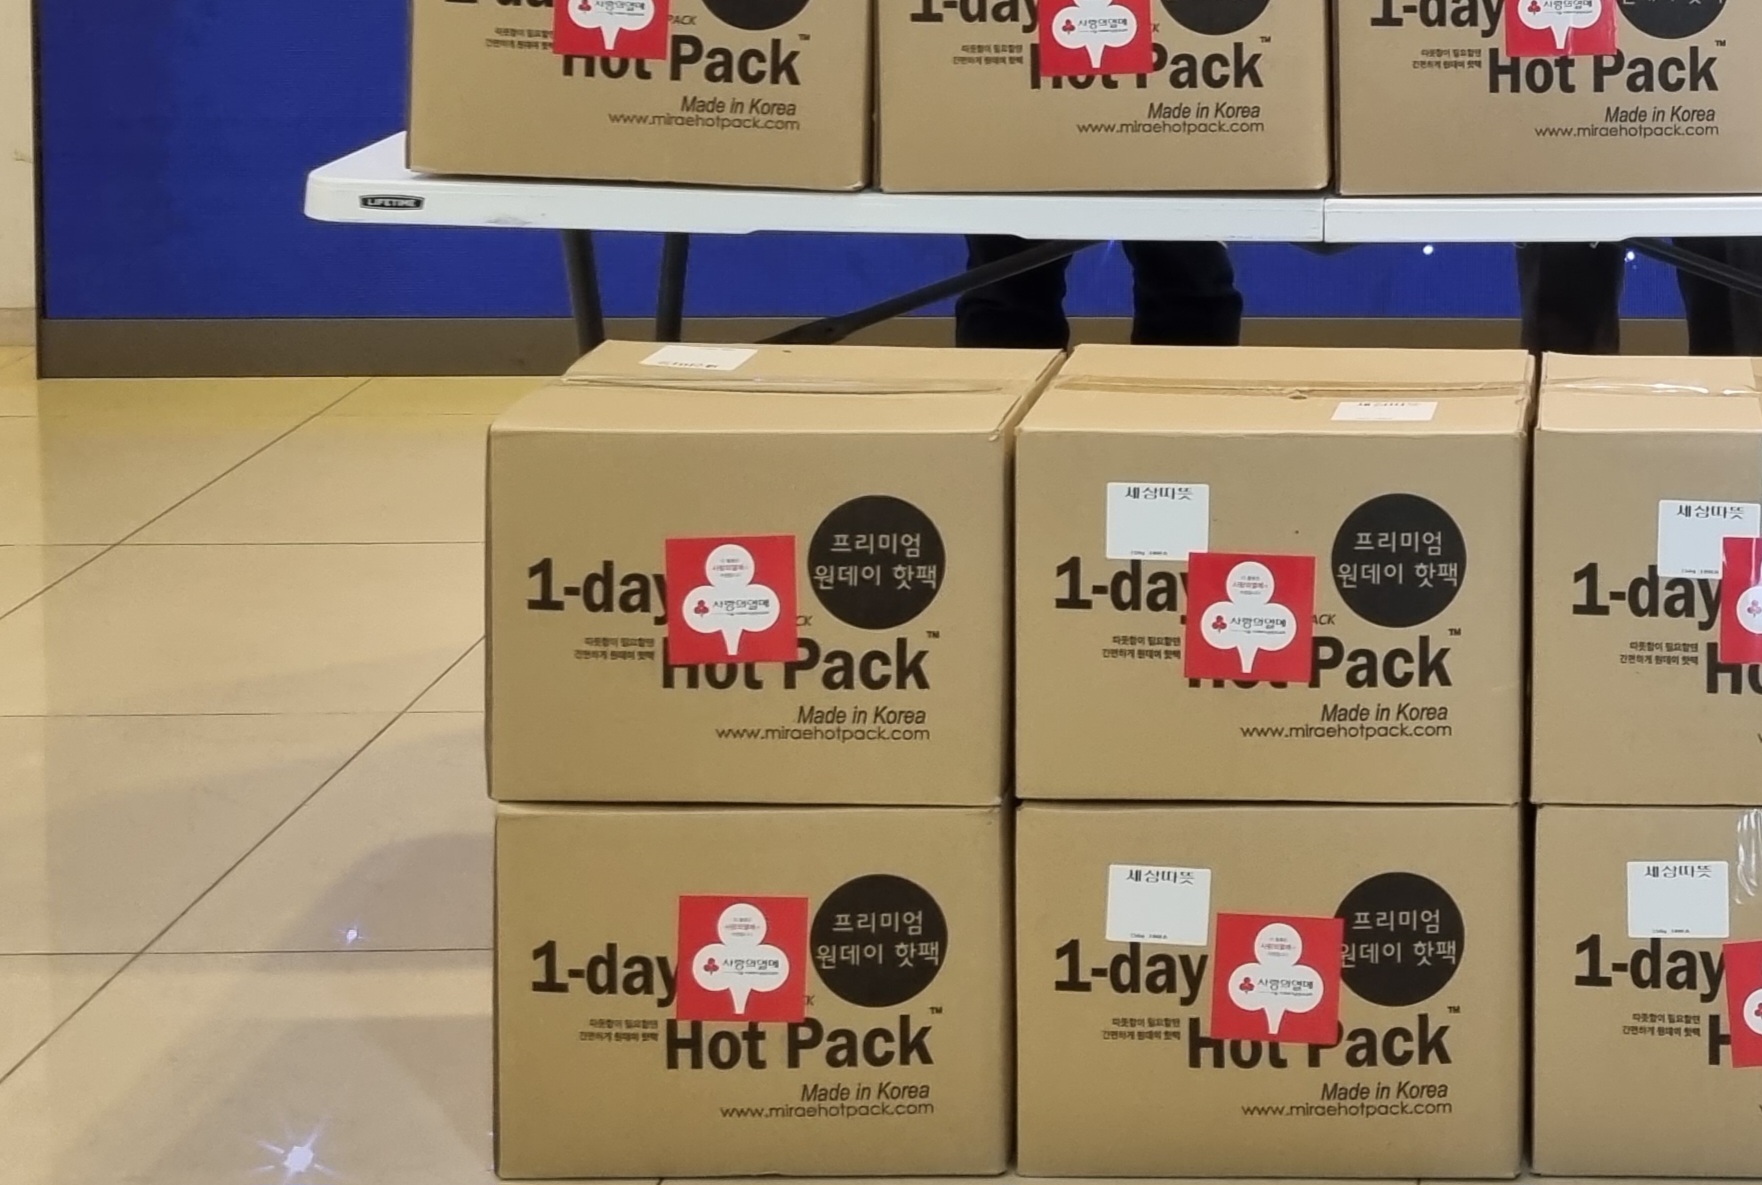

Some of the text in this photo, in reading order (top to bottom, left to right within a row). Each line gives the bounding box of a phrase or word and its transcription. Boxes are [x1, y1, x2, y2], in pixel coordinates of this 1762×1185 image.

[670, 33, 801, 86] Pack
[1489, 46, 1718, 94] Hot Pack
[681, 95, 796, 116] Made in Korea
[1147, 103, 1261, 119] Made in Korea
[1605, 107, 1715, 123] Made in Korea
[608, 113, 800, 131] www.miraehotpack.com
[1077, 121, 1264, 135] www.miraehotpack.com
[1535, 124, 1719, 138] www.miraehotpack.com
[830, 533, 921, 558] 프리미엄
[1354, 531, 1443, 556] 프리미엄
[812, 564, 938, 591] 원데이 핫팩
[1337, 561, 1459, 588] 원데이 핫팩
[1055, 555, 1190, 625] 1-da
[1572, 562, 1722, 631] 1-day
[782, 636, 931, 690] Pack
[1307, 633, 1452, 688] Pack
[797, 706, 926, 725] Made in Korea
[1322, 702, 1448, 722] Made in Korea
[715, 726, 931, 744] www.miraehotpack.com
[1241, 722, 1453, 740] www.miraehotpack.com
[832, 912, 923, 934] 프리미엄
[1353, 909, 1441, 934] 프리미엄
[816, 942, 940, 970] 원데이 핫팩
[1340, 940, 1457, 969] 원데이 핫팩
[531, 940, 677, 1008] 1-day
[1055, 939, 1208, 1006] 1-day
[1575, 933, 1725, 1004] 1-day
[666, 1014, 934, 1070] Hot Pack
[802, 1081, 930, 1102] Made in Korea
[1322, 1081, 1448, 1101] Made in Korea
[721, 1102, 934, 1119] www.miraehotpack.com
[1241, 1102, 1453, 1118] www.miraehotpack.com
